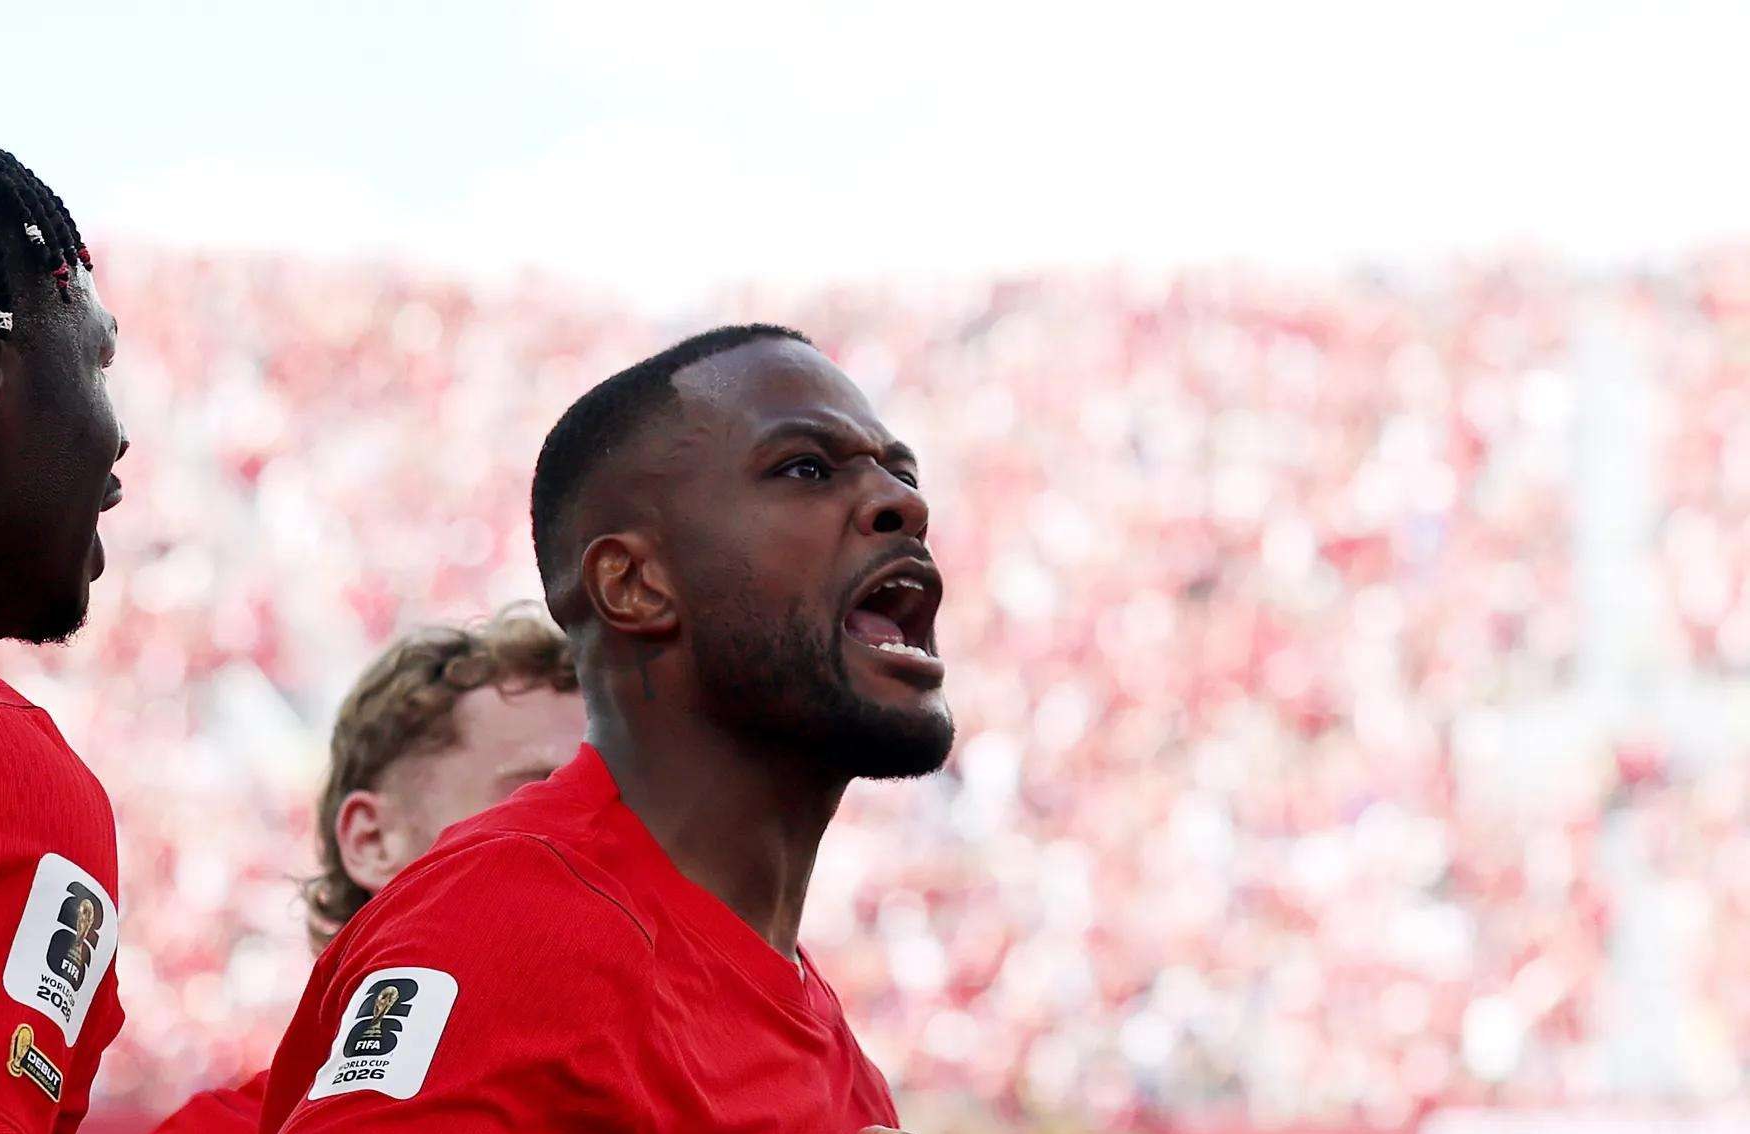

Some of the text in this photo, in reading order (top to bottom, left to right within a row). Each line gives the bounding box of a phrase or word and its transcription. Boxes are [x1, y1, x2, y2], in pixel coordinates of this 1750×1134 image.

[61, 959, 80, 981] FIFA
[354, 1039, 381, 1051] FIFA
[27, 1050, 61, 1086] DEBUT
[368, 1059, 390, 1068] CUP
[332, 1068, 386, 1085] 2026
